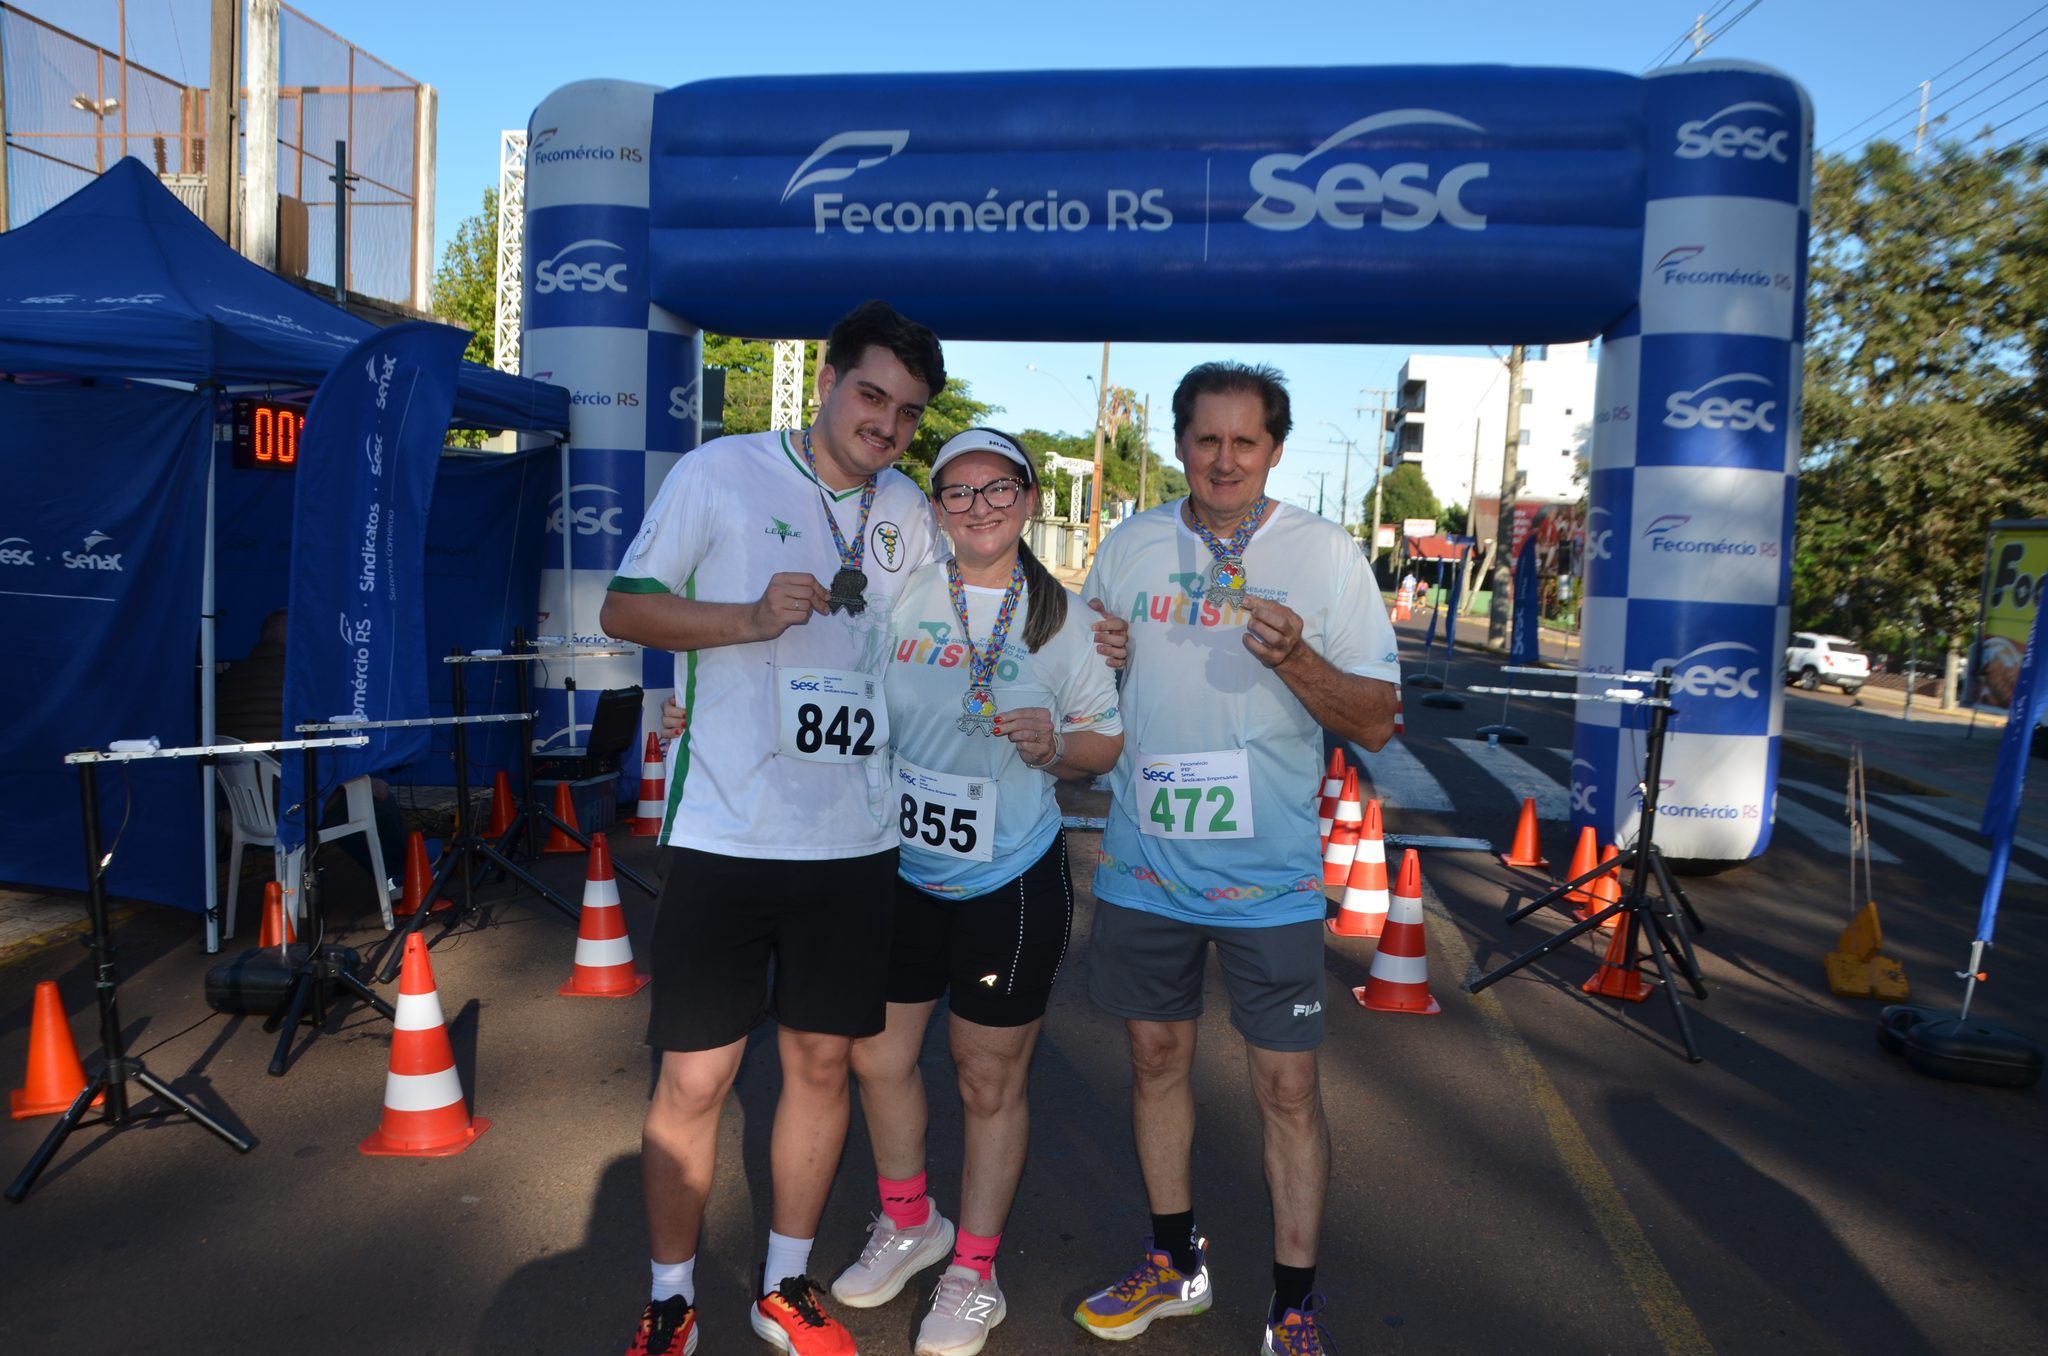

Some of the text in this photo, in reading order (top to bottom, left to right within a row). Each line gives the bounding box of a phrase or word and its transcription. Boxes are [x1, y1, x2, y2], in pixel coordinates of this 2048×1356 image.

[535, 145, 643, 165] Fecomércio RS
[1673, 119, 1789, 164] Sesc
[1243, 152, 1490, 232] Sesc
[813, 187, 1174, 234] Fecomércio RS
[535, 260, 628, 294] Sesc
[1664, 269, 1771, 288] Fecomércio
[376, 354, 397, 410] Senac
[569, 390, 640, 407] ércio RS
[1662, 390, 1776, 433] Sesc
[371, 433, 383, 477] Sesc
[546, 507, 623, 537] esc
[0, 549, 123, 571] esc Senac
[359, 503, 380, 592] Sindicatos
[1653, 536, 1778, 558] Fecomércio RS
[355, 618, 372, 643] RS
[790, 680, 820, 691] Sesc
[796, 702, 876, 756] 842
[1142, 767, 1175, 782] Sesc
[900, 793, 978, 853] 855
[1150, 785, 1238, 832] 472
[1637, 799, 1760, 819] Fcomércio RS
[1293, 1001, 1322, 1017] FILA
